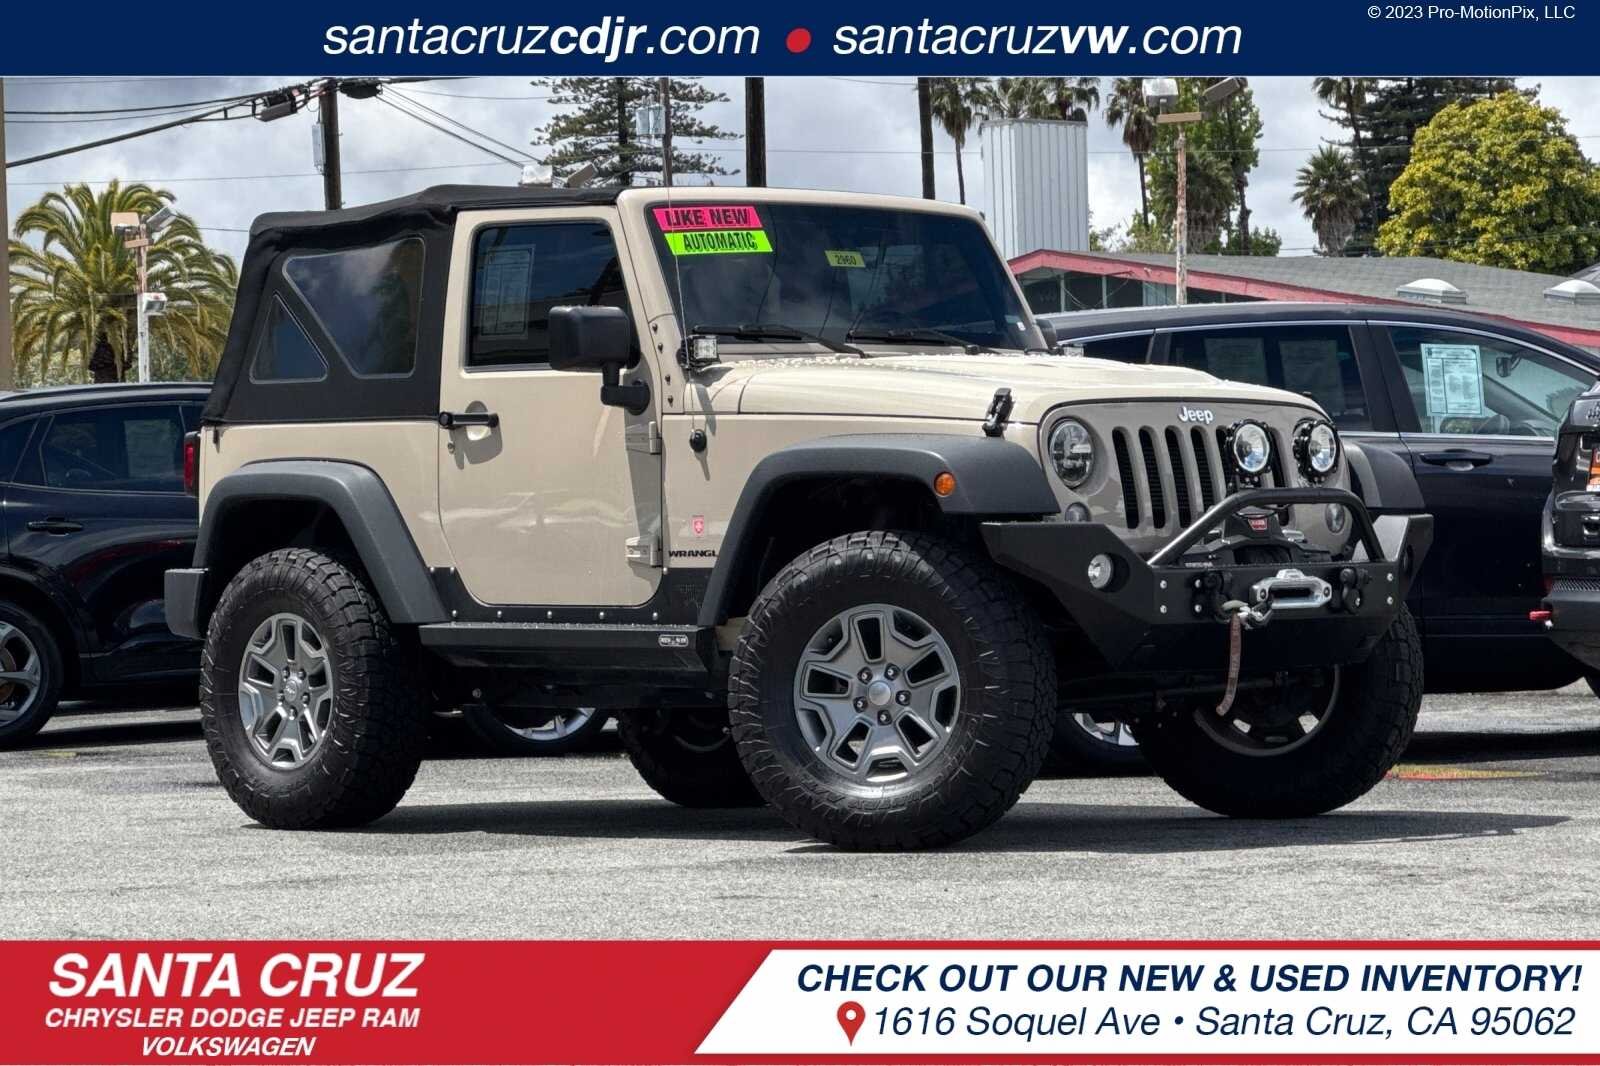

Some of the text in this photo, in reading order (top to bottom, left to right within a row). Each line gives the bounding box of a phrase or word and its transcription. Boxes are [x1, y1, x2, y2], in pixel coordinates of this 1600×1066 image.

[663, 207, 748, 227] LIKE NEW
[683, 232, 757, 250] AUTOMATIC
[1179, 406, 1214, 425] Jeep
